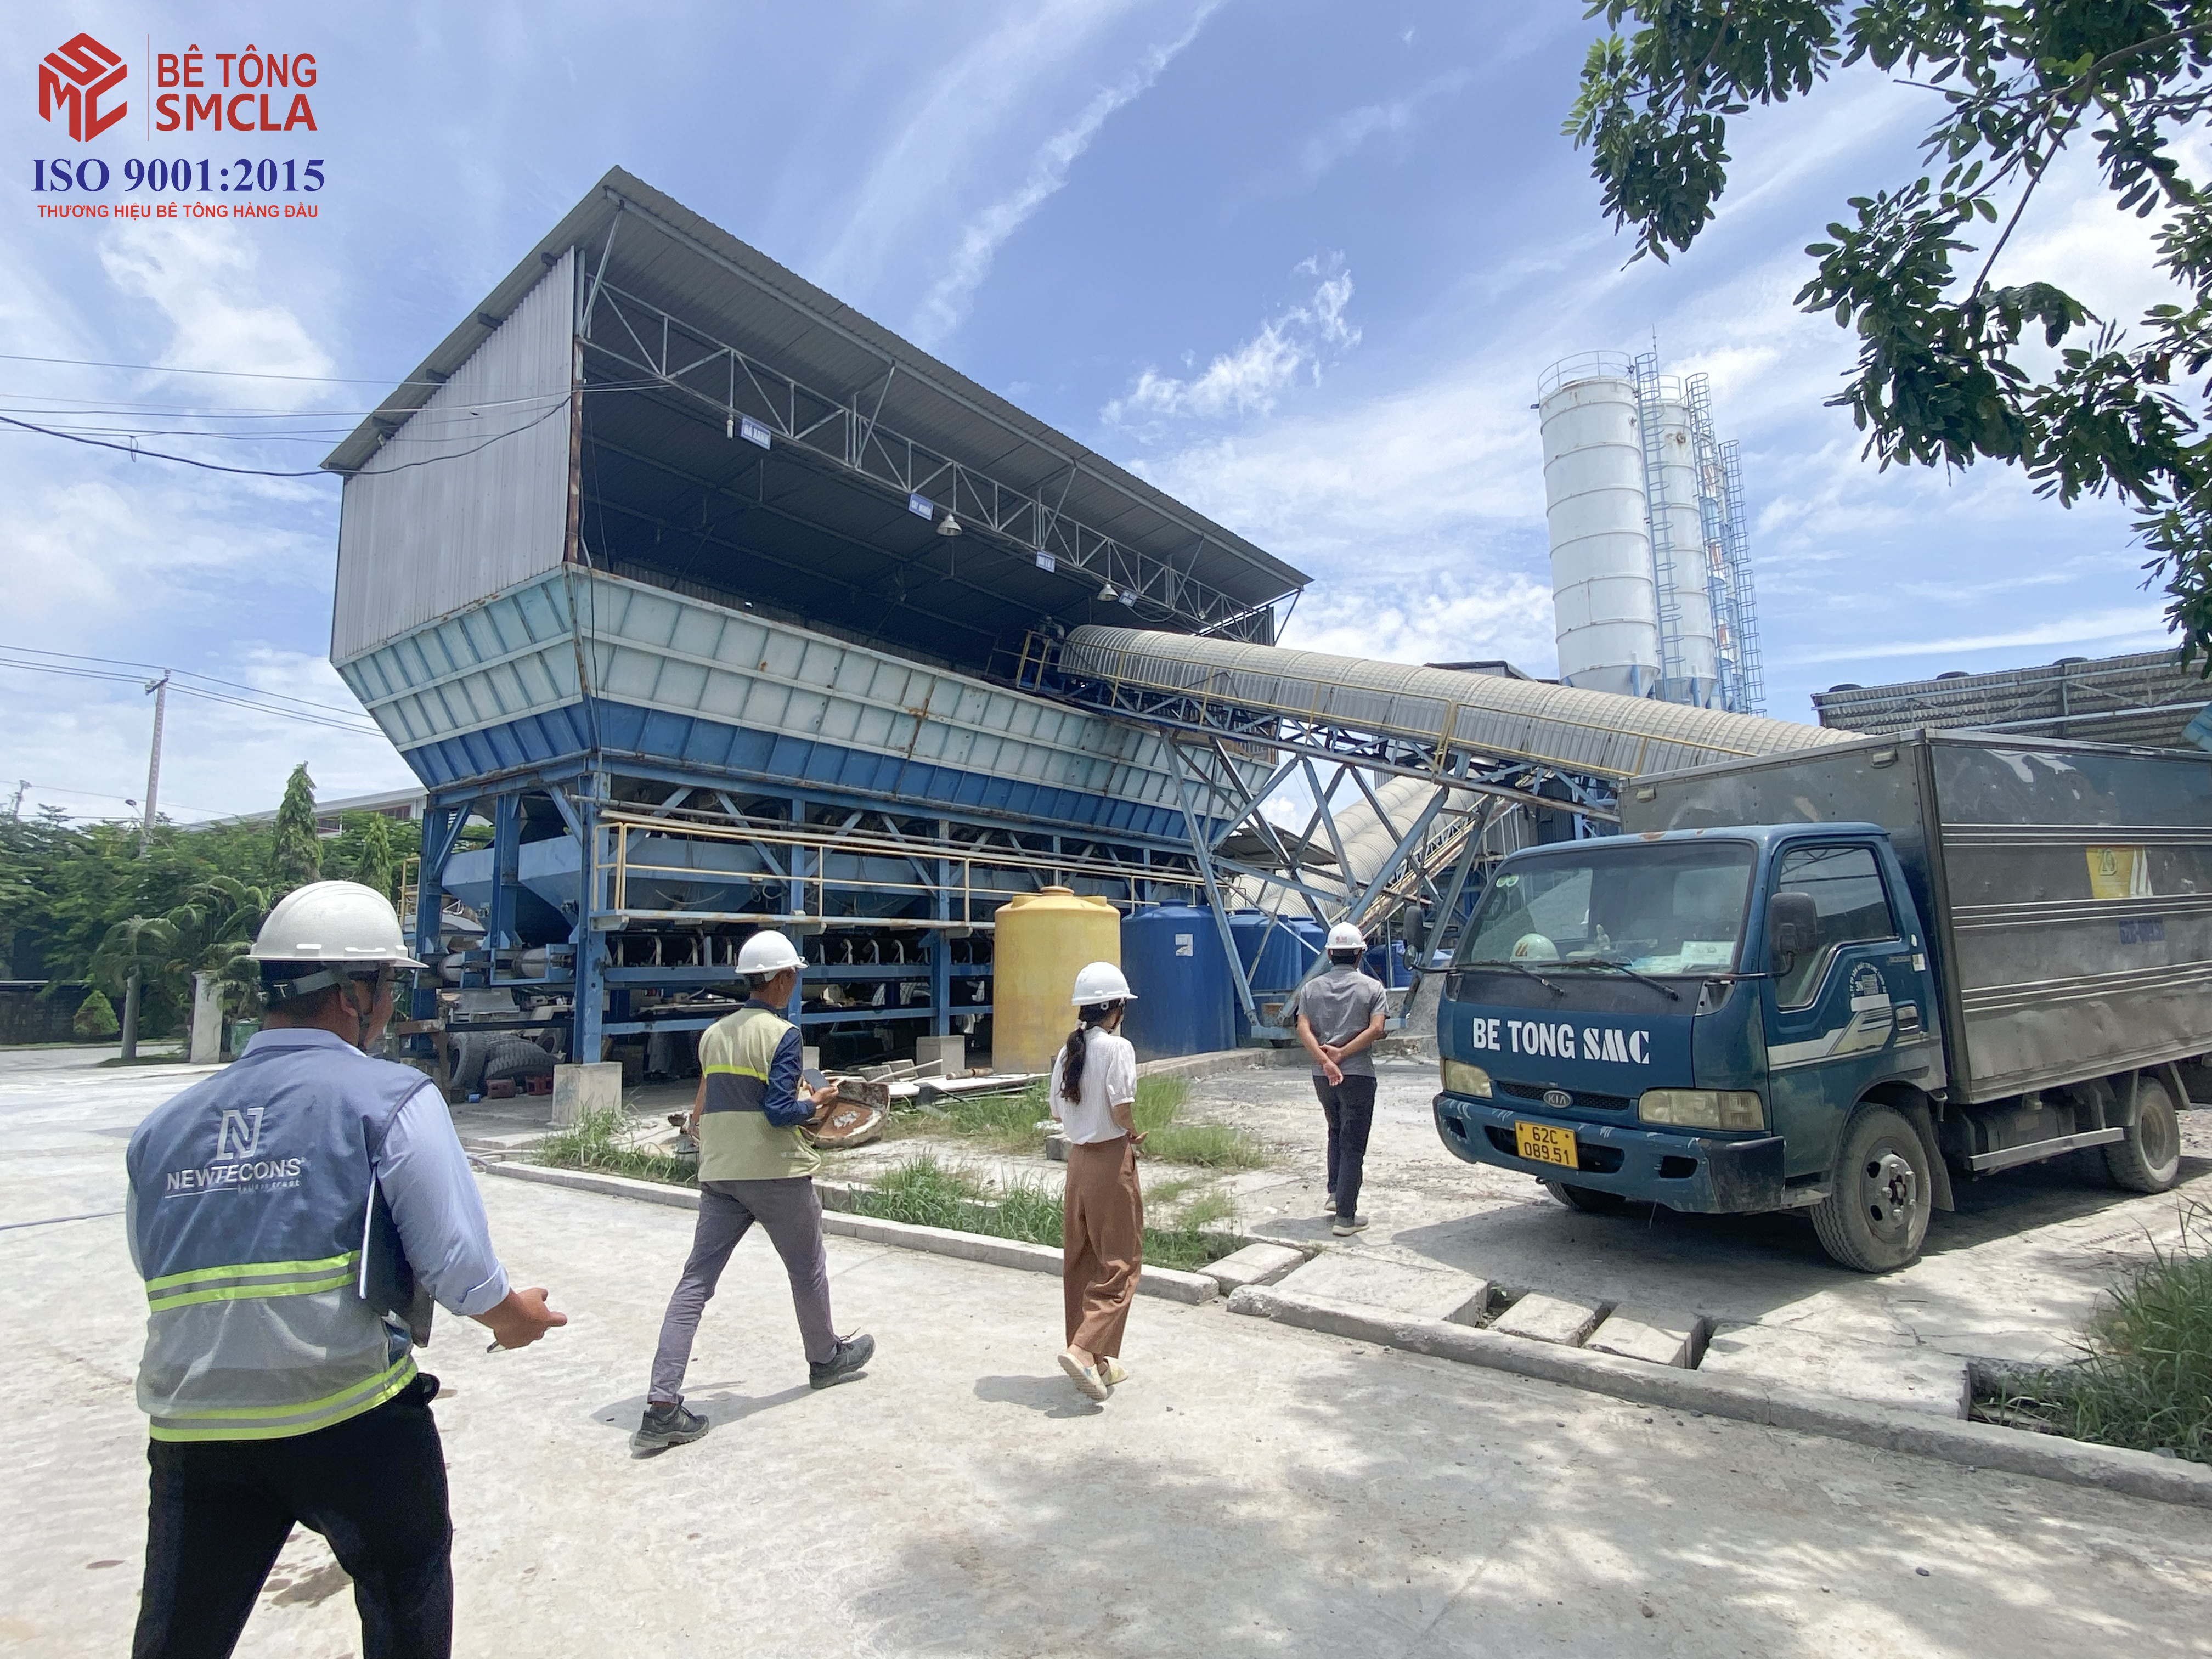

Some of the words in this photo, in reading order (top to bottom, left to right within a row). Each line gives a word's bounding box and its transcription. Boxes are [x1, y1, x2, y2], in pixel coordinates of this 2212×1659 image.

[1473, 1018, 1500, 1051] BE
[1508, 1020, 1575, 1059] TONG
[1583, 1027, 1650, 1064] SMC
[1548, 1094, 1566, 1104] KIA
[1532, 1127, 1558, 1144] 62C
[1524, 1142, 1570, 1165] 089.51
[166, 1158, 302, 1190] NEWTECONS
